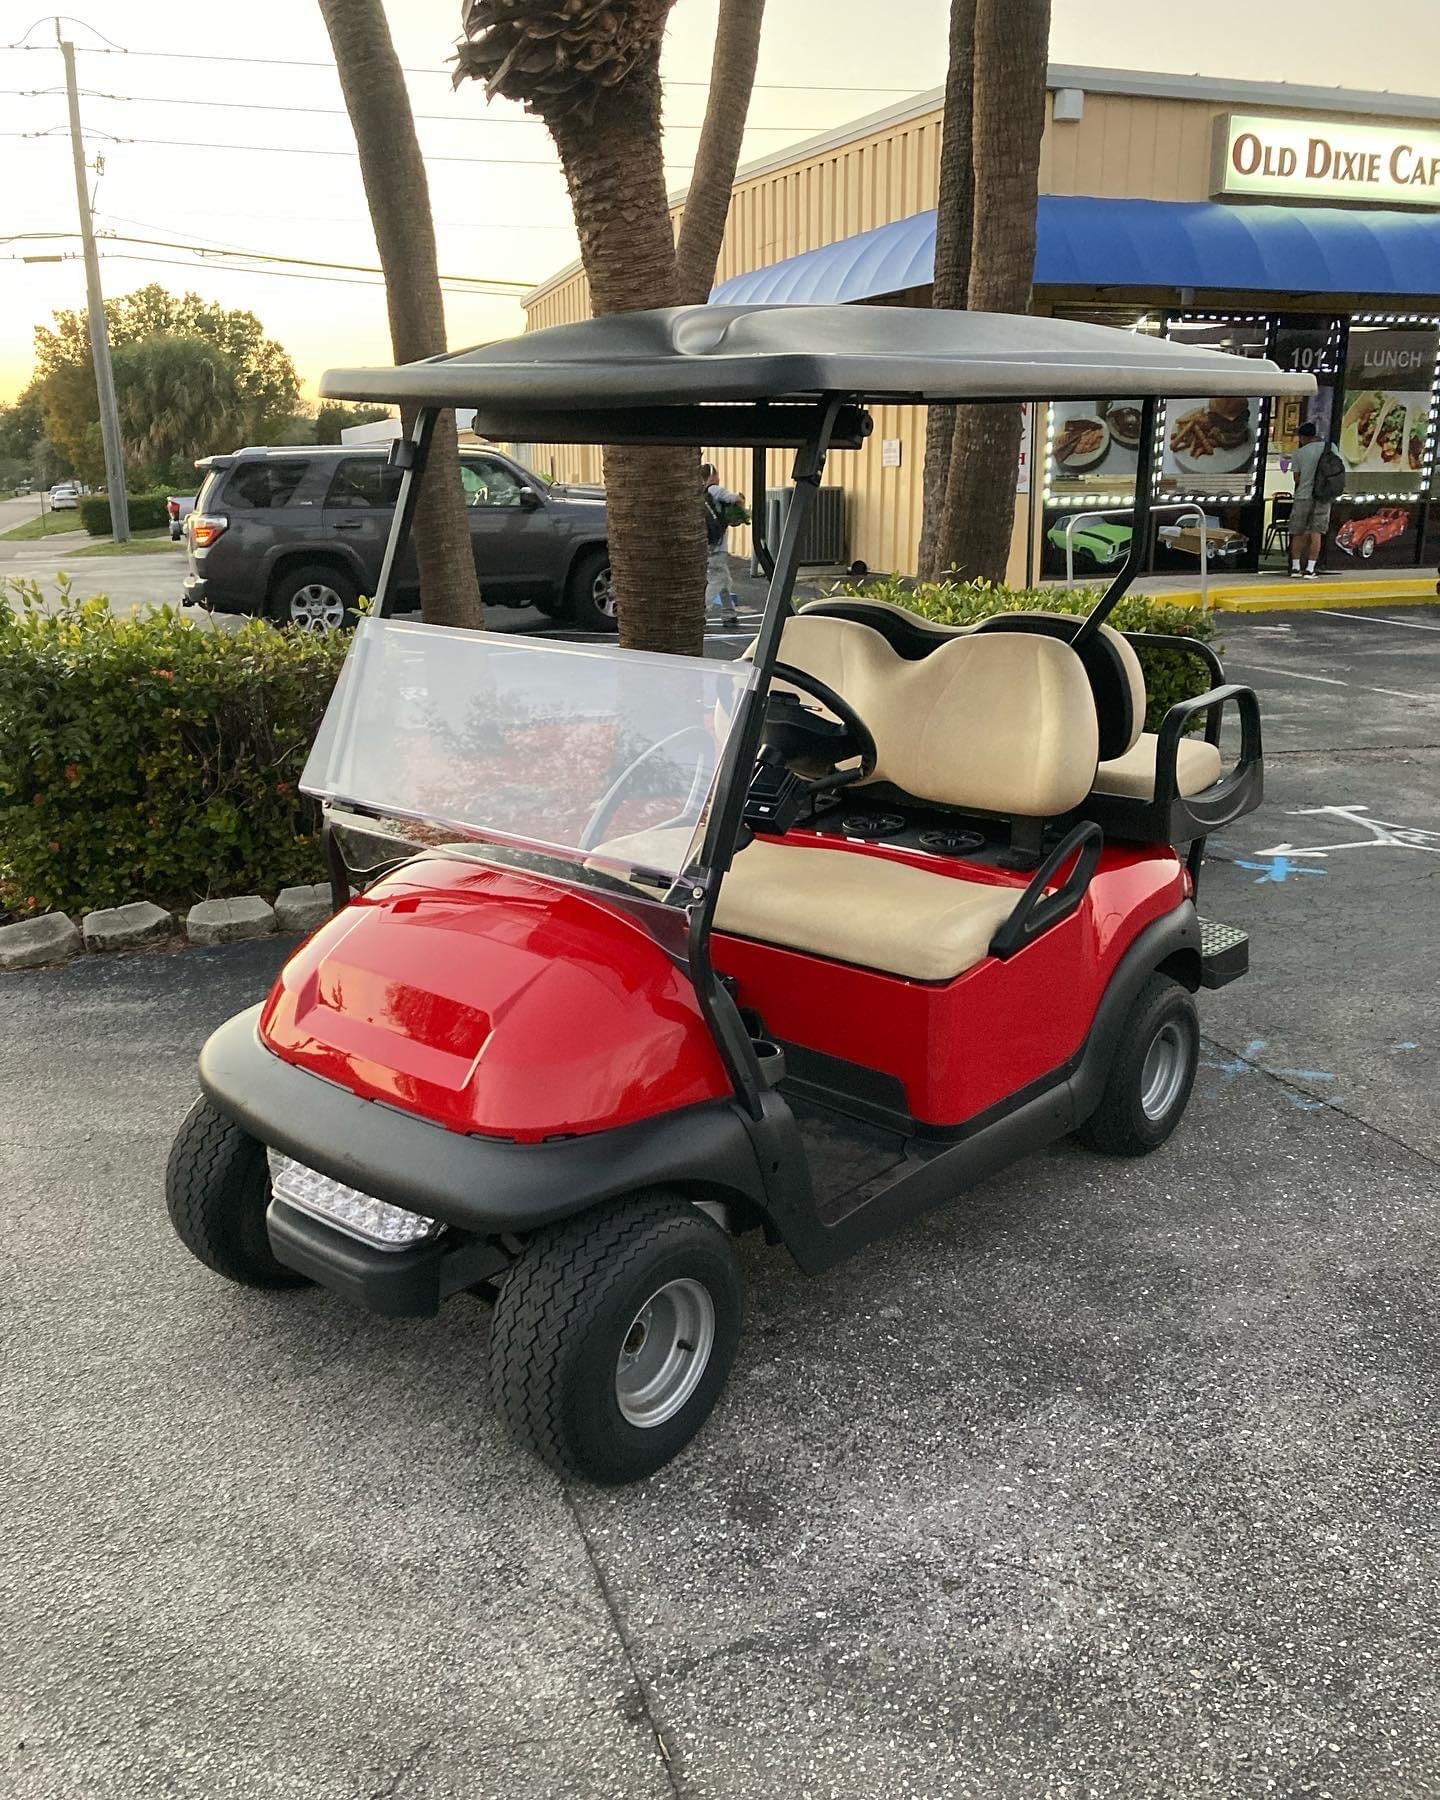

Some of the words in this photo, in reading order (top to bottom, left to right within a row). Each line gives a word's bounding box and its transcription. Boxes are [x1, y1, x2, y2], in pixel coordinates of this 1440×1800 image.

[1232, 133, 1297, 177] OLD
[1305, 138, 1381, 182] DIXIE
[1291, 347, 1323, 368] 101
[1363, 350, 1422, 368] LUNCH
